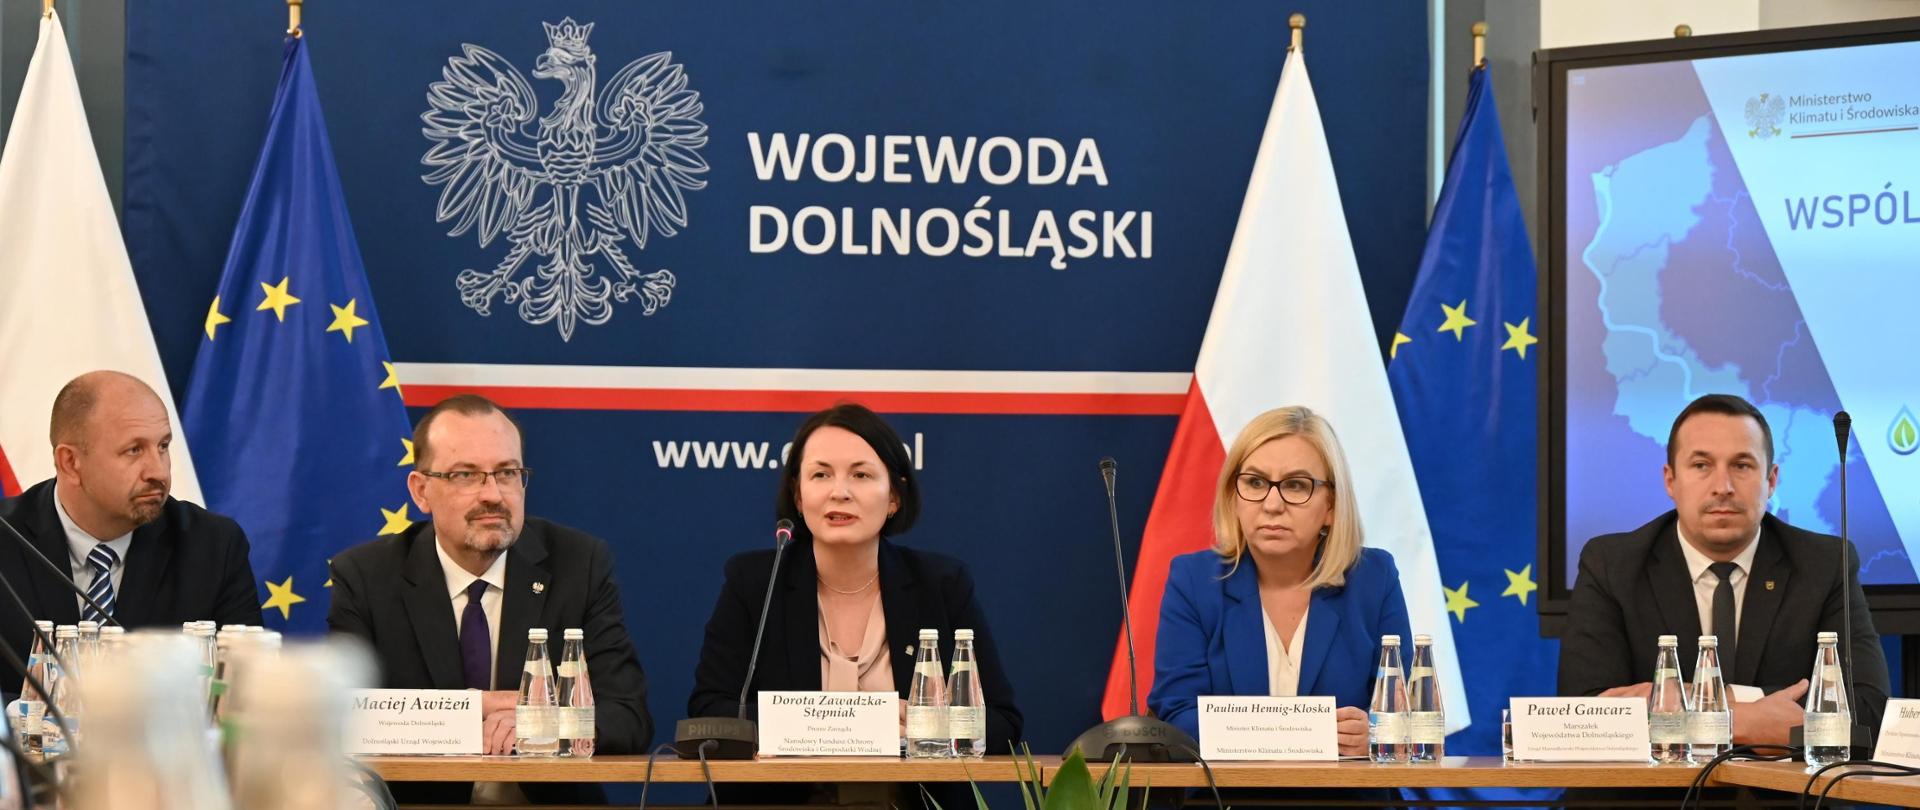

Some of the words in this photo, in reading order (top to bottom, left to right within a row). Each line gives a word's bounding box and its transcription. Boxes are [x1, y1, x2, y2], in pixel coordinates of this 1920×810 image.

[1789, 92, 1872, 107] Ministerstwo
[1789, 111, 1838, 124] Klimatu
[1840, 109, 1844, 120] i
[1846, 104, 1919, 121] Środowiska
[747, 131, 1109, 186] WOJEWODA
[1784, 181, 1920, 230] WSPÓL
[748, 195, 1153, 270] DOLNOŚLĄSKI
[352, 697, 406, 715] Maciej
[410, 697, 470, 710] Awiżeń
[772, 694, 815, 706] Dorota
[818, 695, 887, 706] Zawadzka-
[803, 707, 856, 720] Stępniak
[1206, 703, 1248, 713] Paulina
[1251, 703, 1331, 716] Hennig-Kloska
[1527, 703, 1571, 716] Paweł
[1575, 703, 1632, 716] Gancarz
[688, 724, 740, 736] PHILIPS
[1122, 727, 1167, 737] BOSCH
[1563, 722, 1599, 730] Marszałek
[1531, 731, 1581, 740] Województwa
[1582, 731, 1634, 740] Dolnośląskiego
